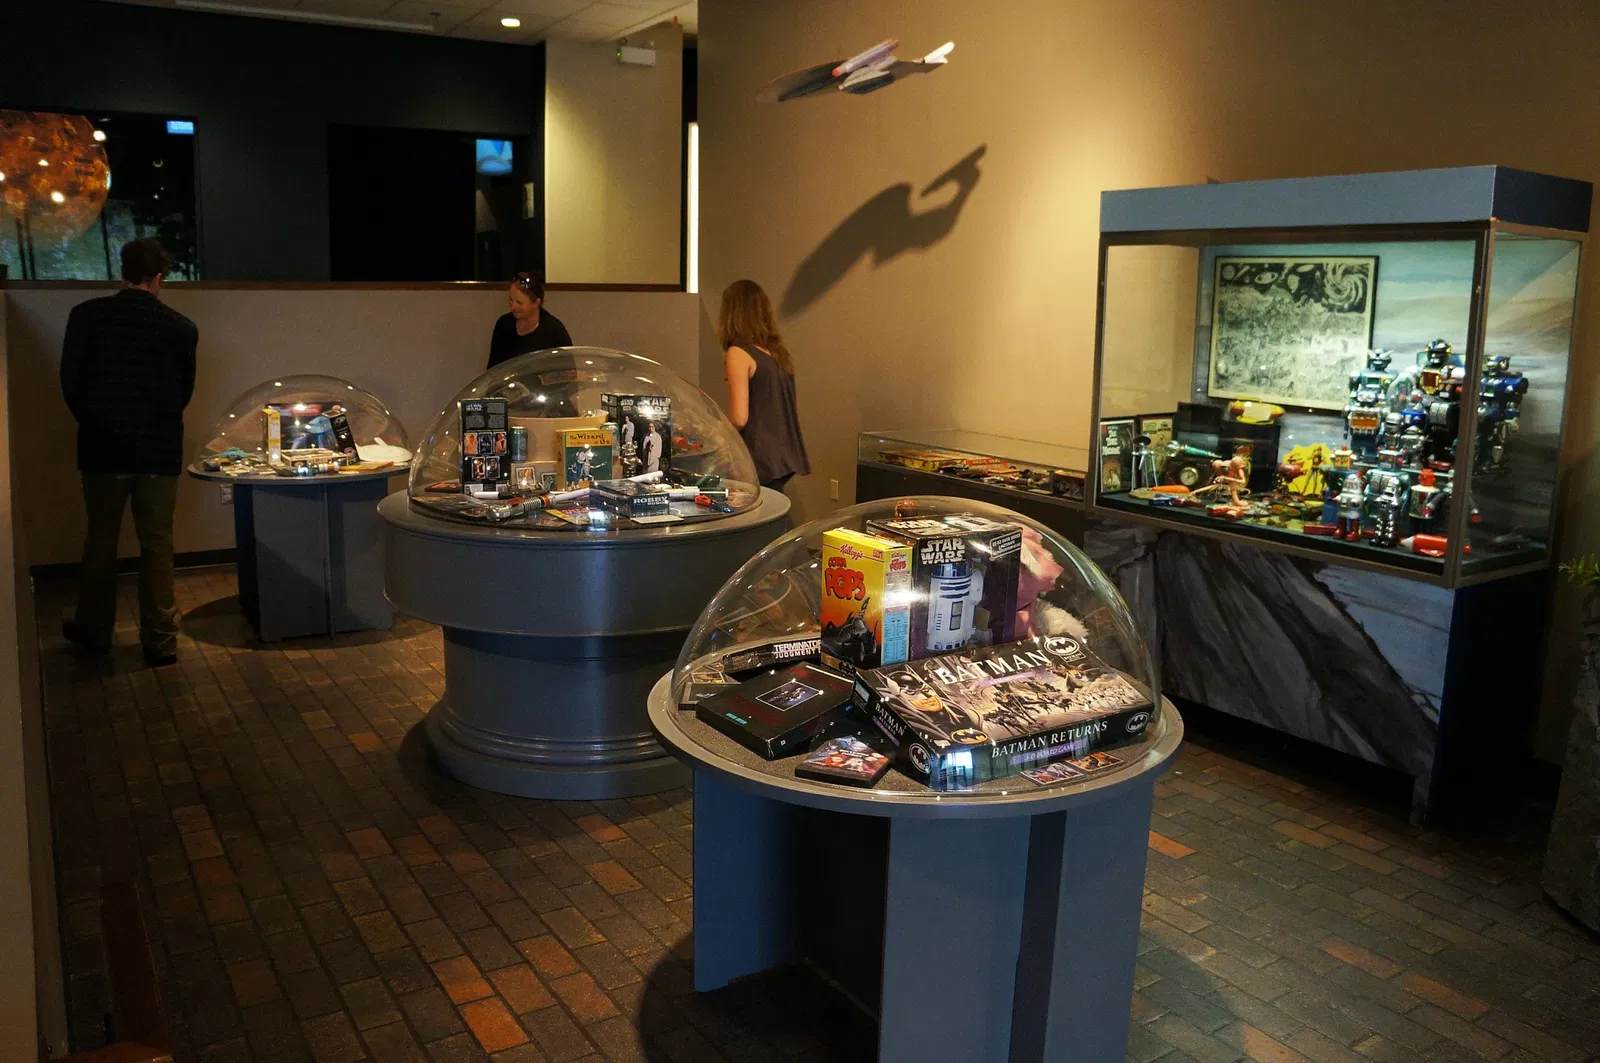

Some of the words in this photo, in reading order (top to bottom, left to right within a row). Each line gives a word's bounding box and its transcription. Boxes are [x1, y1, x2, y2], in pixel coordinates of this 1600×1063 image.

[839, 543, 863, 561] Kellogg's
[921, 538, 966, 553] STAR
[921, 550, 966, 565] WARS
[824, 567, 867, 602] POPS
[775, 648, 816, 660] JUDGMENT
[934, 649, 1053, 685] BATMAN
[875, 703, 905, 736] BATMAN
[991, 735, 1047, 758] BATMAN
[1051, 720, 1108, 744] RETURNS
[1036, 747, 1058, 759] BOARD
[1058, 743, 1074, 753] GAM
